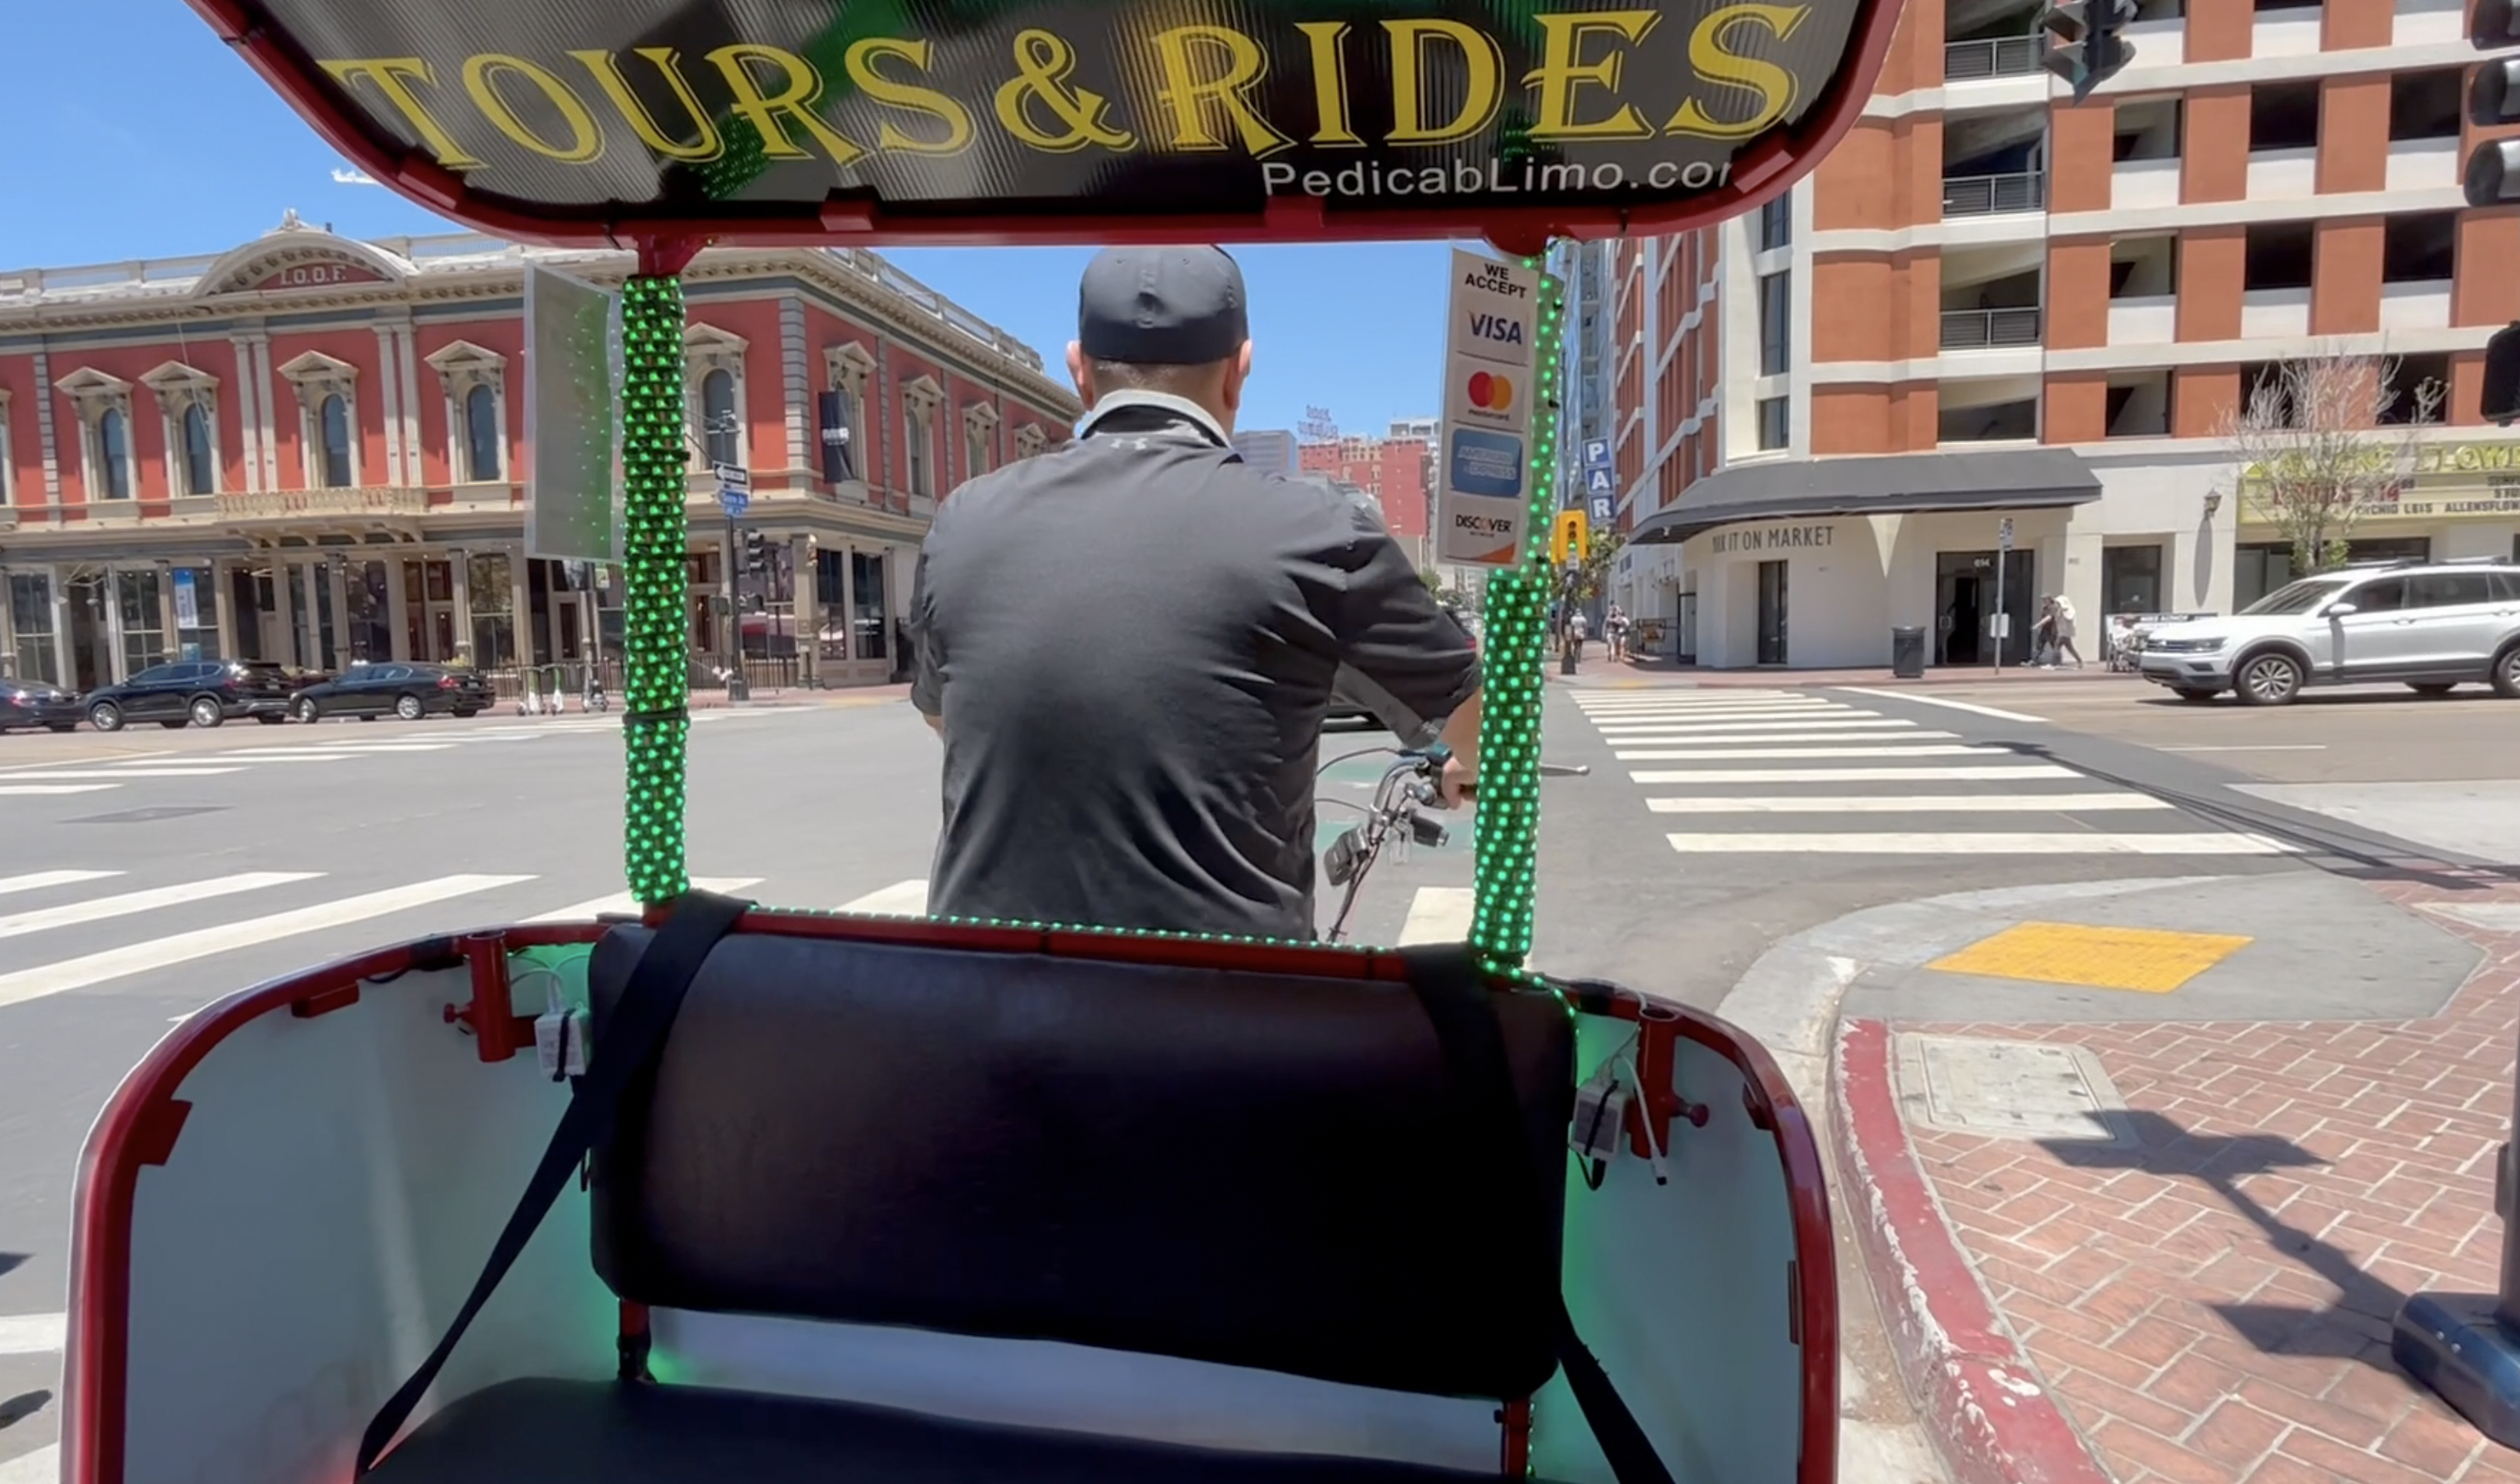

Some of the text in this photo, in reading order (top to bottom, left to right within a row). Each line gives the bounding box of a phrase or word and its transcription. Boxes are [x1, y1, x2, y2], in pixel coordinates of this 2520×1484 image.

[1484, 263, 1509, 280] WE
[1465, 273, 1526, 298] ACCEPT
[1467, 312, 1521, 345] VISA
[1456, 514, 1512, 533] DISCOVER
[1729, 532, 1739, 552] IT
[1743, 531, 1761, 550] ON
[1768, 525, 1834, 548] MARKET
